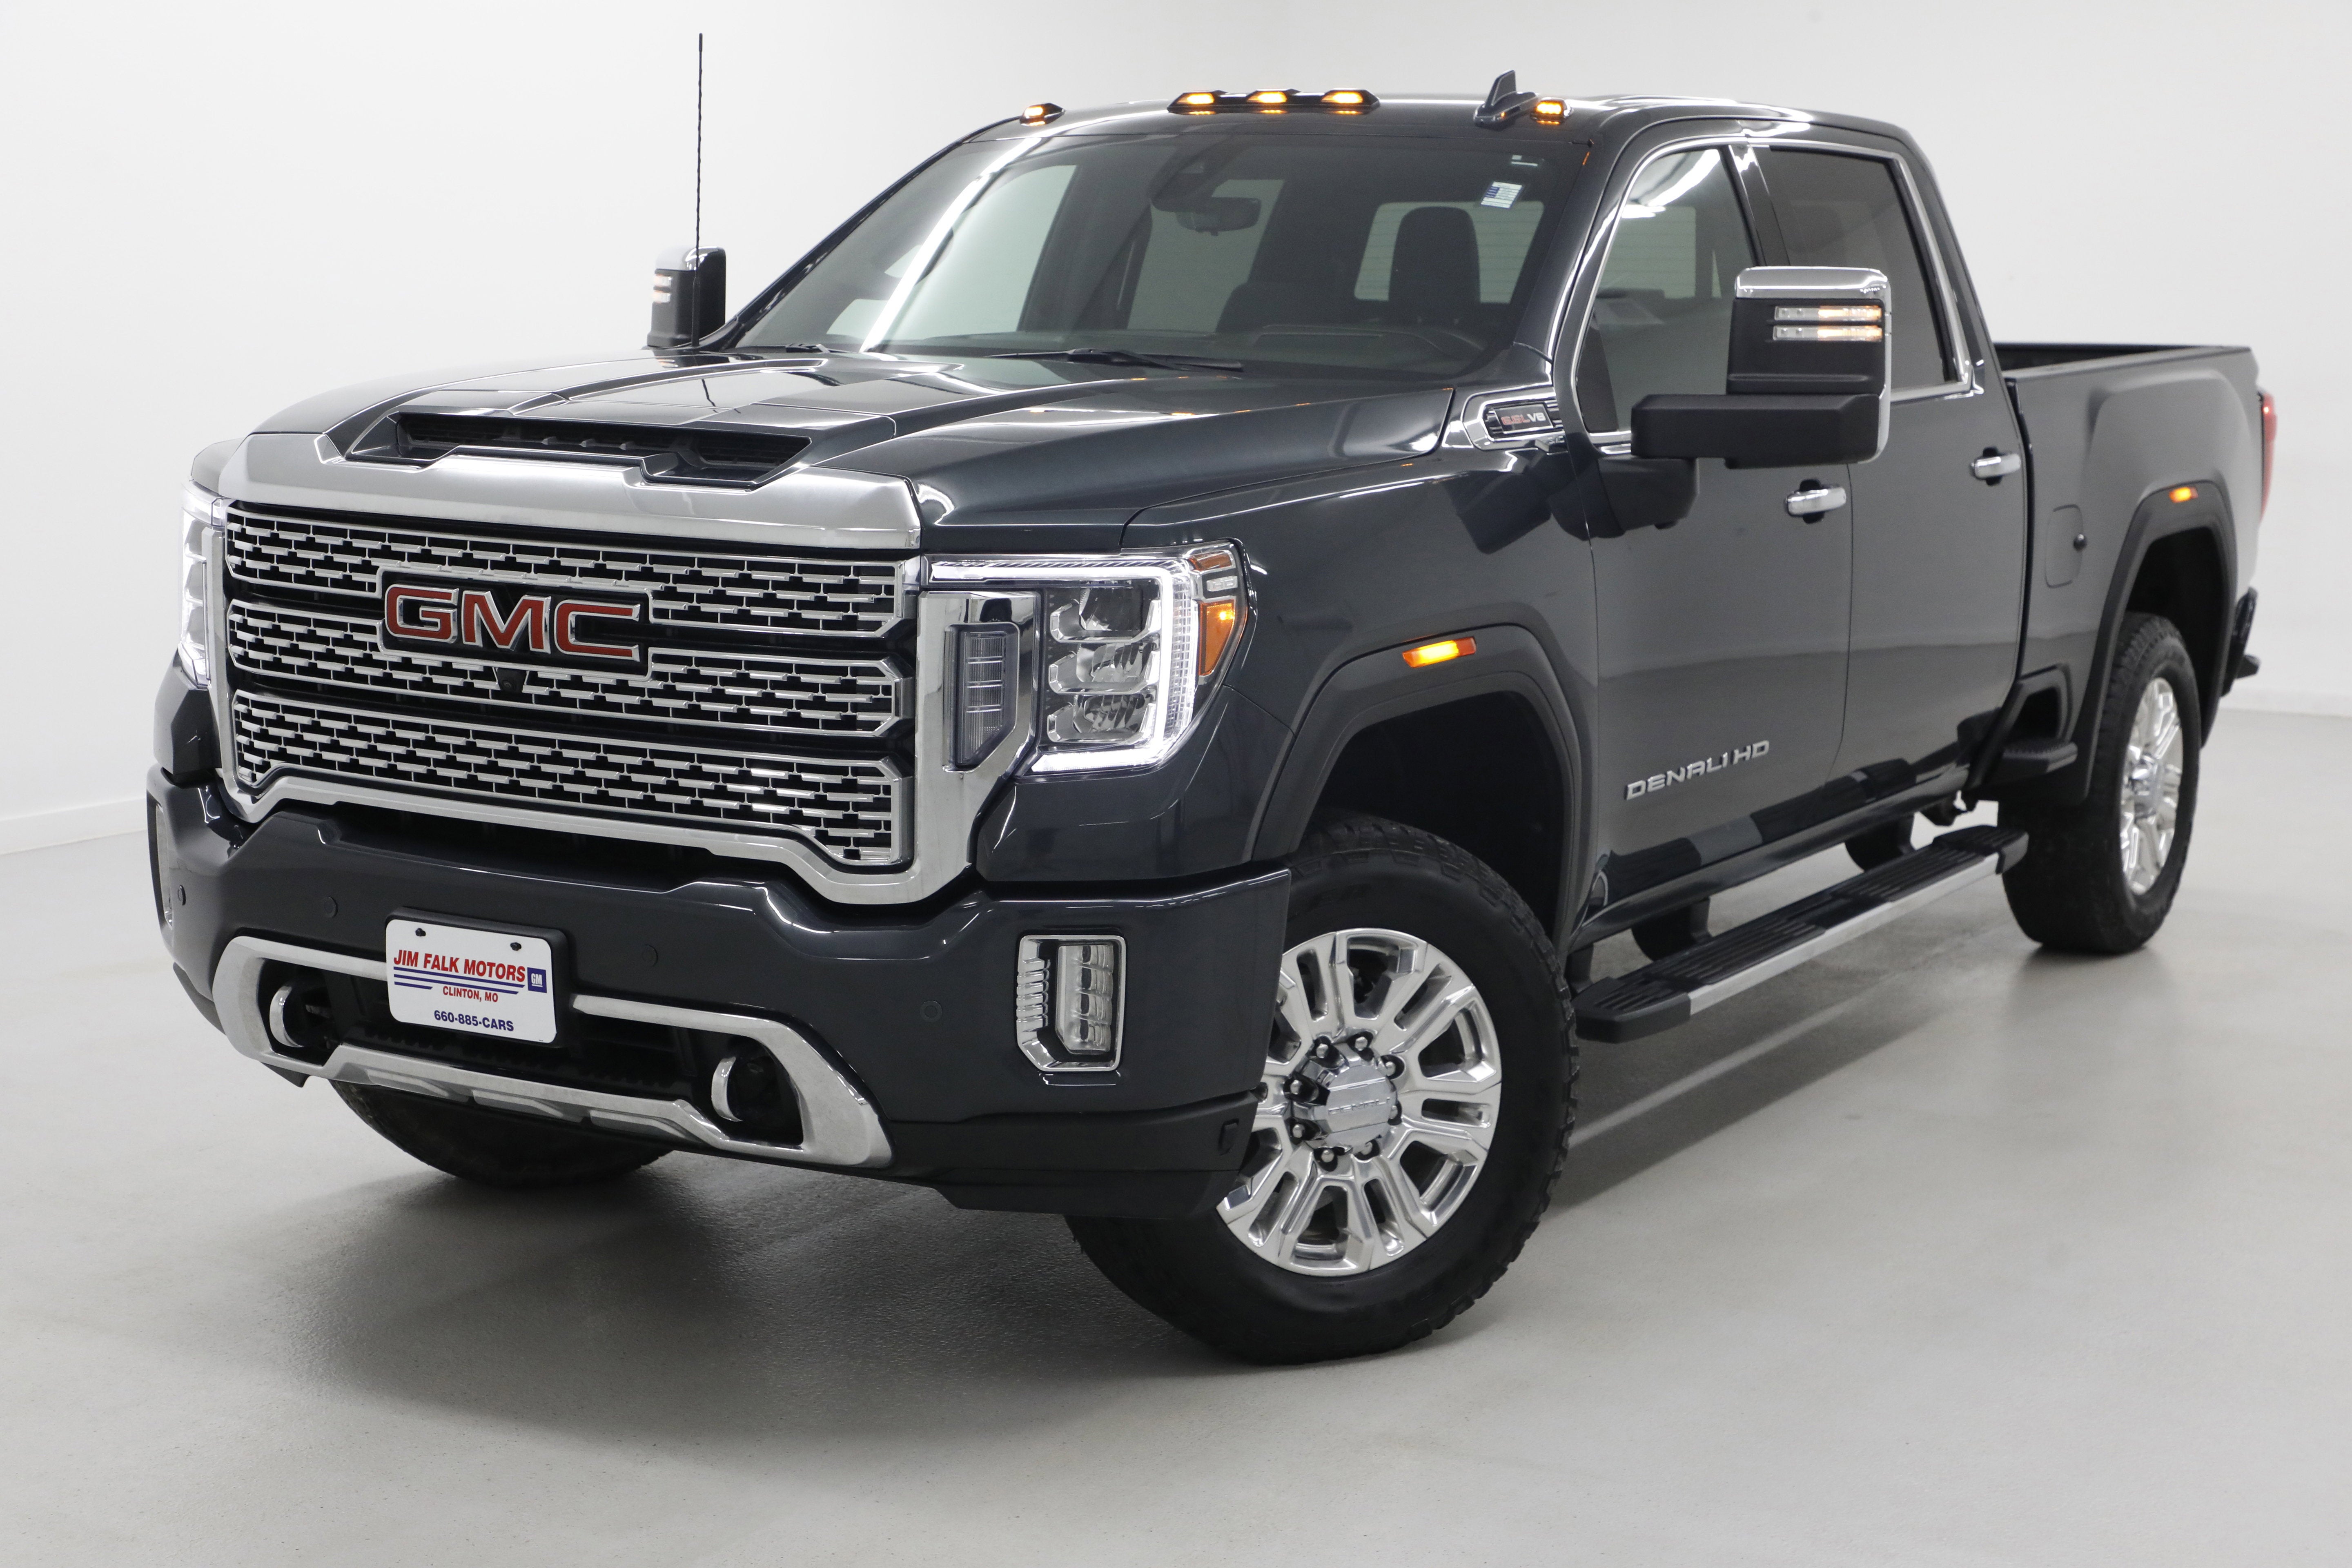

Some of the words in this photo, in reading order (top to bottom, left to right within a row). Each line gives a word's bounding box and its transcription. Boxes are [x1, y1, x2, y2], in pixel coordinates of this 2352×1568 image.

[1527, 412, 1546, 422] V8
[385, 584, 641, 662] GMC
[1626, 752, 1728, 800] DENALI
[1733, 740, 1770, 765] HD
[394, 949, 419, 967] JIM
[423, 953, 460, 973] FALK
[464, 959, 526, 982] MOTORS
[531, 973, 543, 986] GM
[443, 986, 482, 1002] CLINTON,
[485, 992, 498, 1002] MO
[434, 1010, 514, 1031] 660-885-CARS
[1328, 1097, 1390, 1116] DENALI
